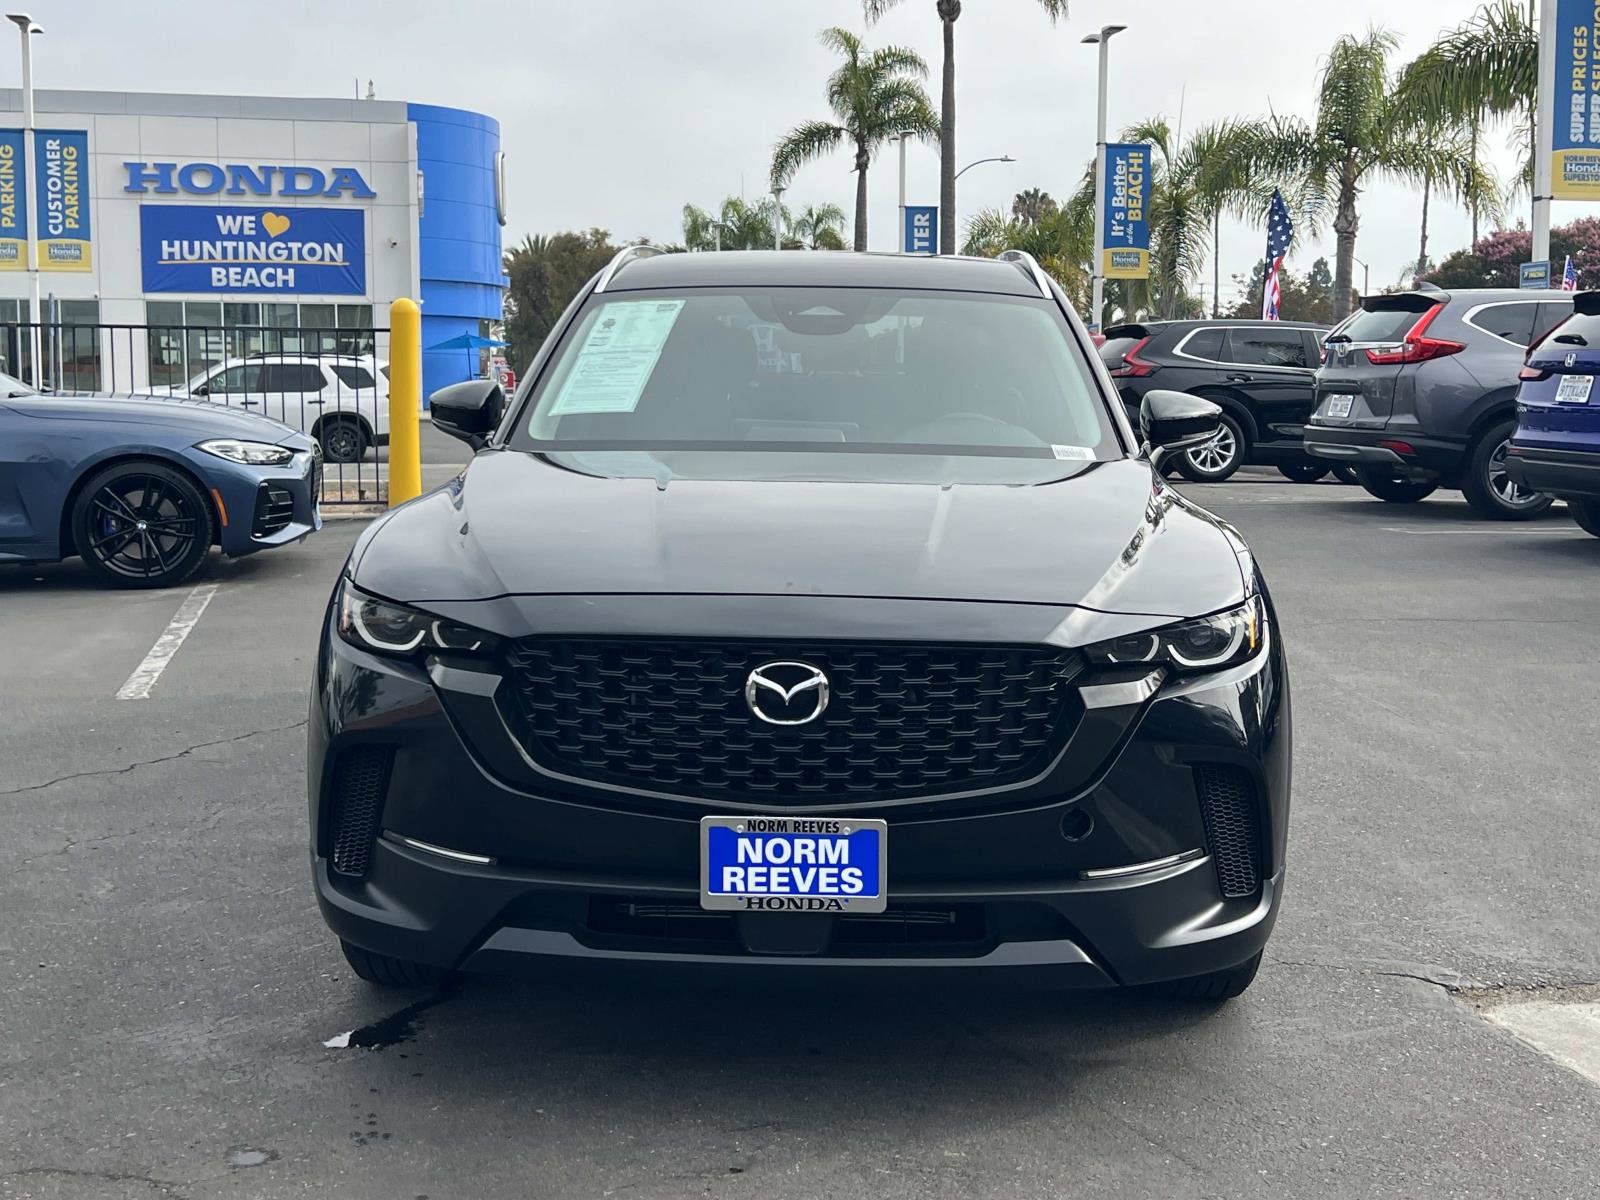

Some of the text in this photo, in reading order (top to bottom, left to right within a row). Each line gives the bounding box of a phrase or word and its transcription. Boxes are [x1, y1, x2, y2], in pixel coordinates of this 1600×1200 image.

[1570, 25, 1588, 143] SUPER PRICES
[1589, 0, 1600, 143] SUPER SELECTIO
[123, 162, 377, 198] HONDA
[1564, 173, 1600, 181] SUPERSTO
[1566, 163, 1600, 172] Hond
[0, 144, 15, 228] PARKING
[46, 138, 63, 235] CUSTOMER
[63, 145, 79, 229] PARKING
[1111, 156, 1127, 237] It's Better
[1128, 152, 1144, 221] BEACH!
[216, 214, 257, 235] WE
[913, 213, 930, 253] TER
[161, 240, 344, 262] HUNTINGTON
[211, 267, 295, 288] BEACH
[747, 819, 840, 834] NORM REEVES
[737, 838, 849, 865] NORM
[722, 867, 864, 894] REEVES
[745, 897, 844, 911] HONDA
